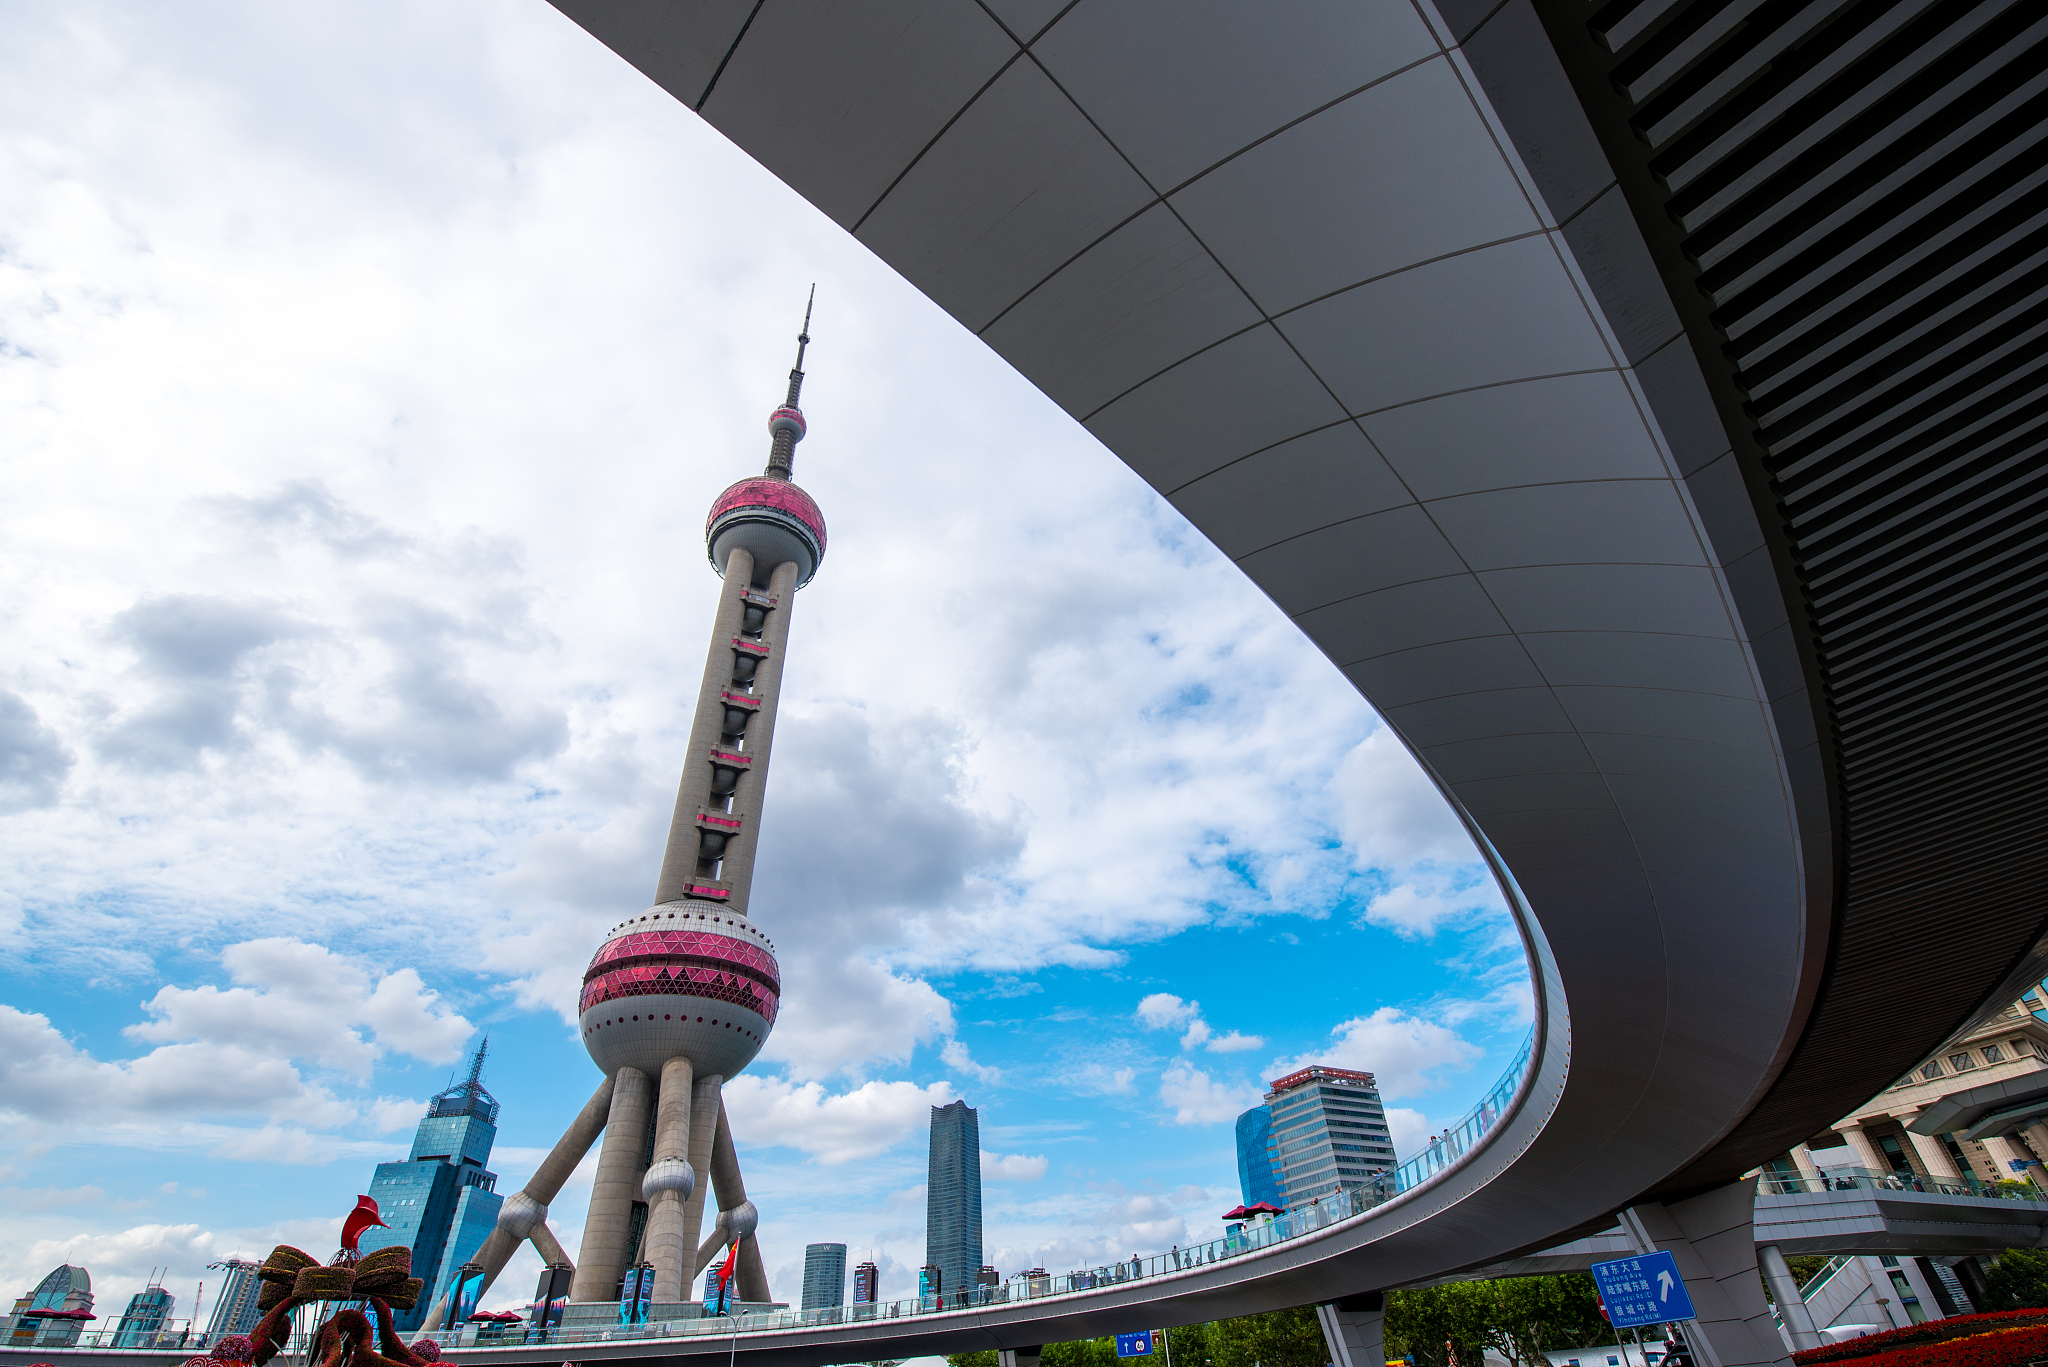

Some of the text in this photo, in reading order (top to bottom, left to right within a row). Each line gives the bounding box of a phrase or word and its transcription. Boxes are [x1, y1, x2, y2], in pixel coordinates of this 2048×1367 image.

[1599, 1260, 1642, 1277] 浦东大道
[1603, 1275, 1629, 1283] Pudong
[1605, 1279, 1650, 1296] 陆家嘴东路
[1610, 1295, 1636, 1304] Lujiazui
[1614, 1300, 1658, 1317] 银城中路
[1617, 1315, 1645, 1323] Yincheng
